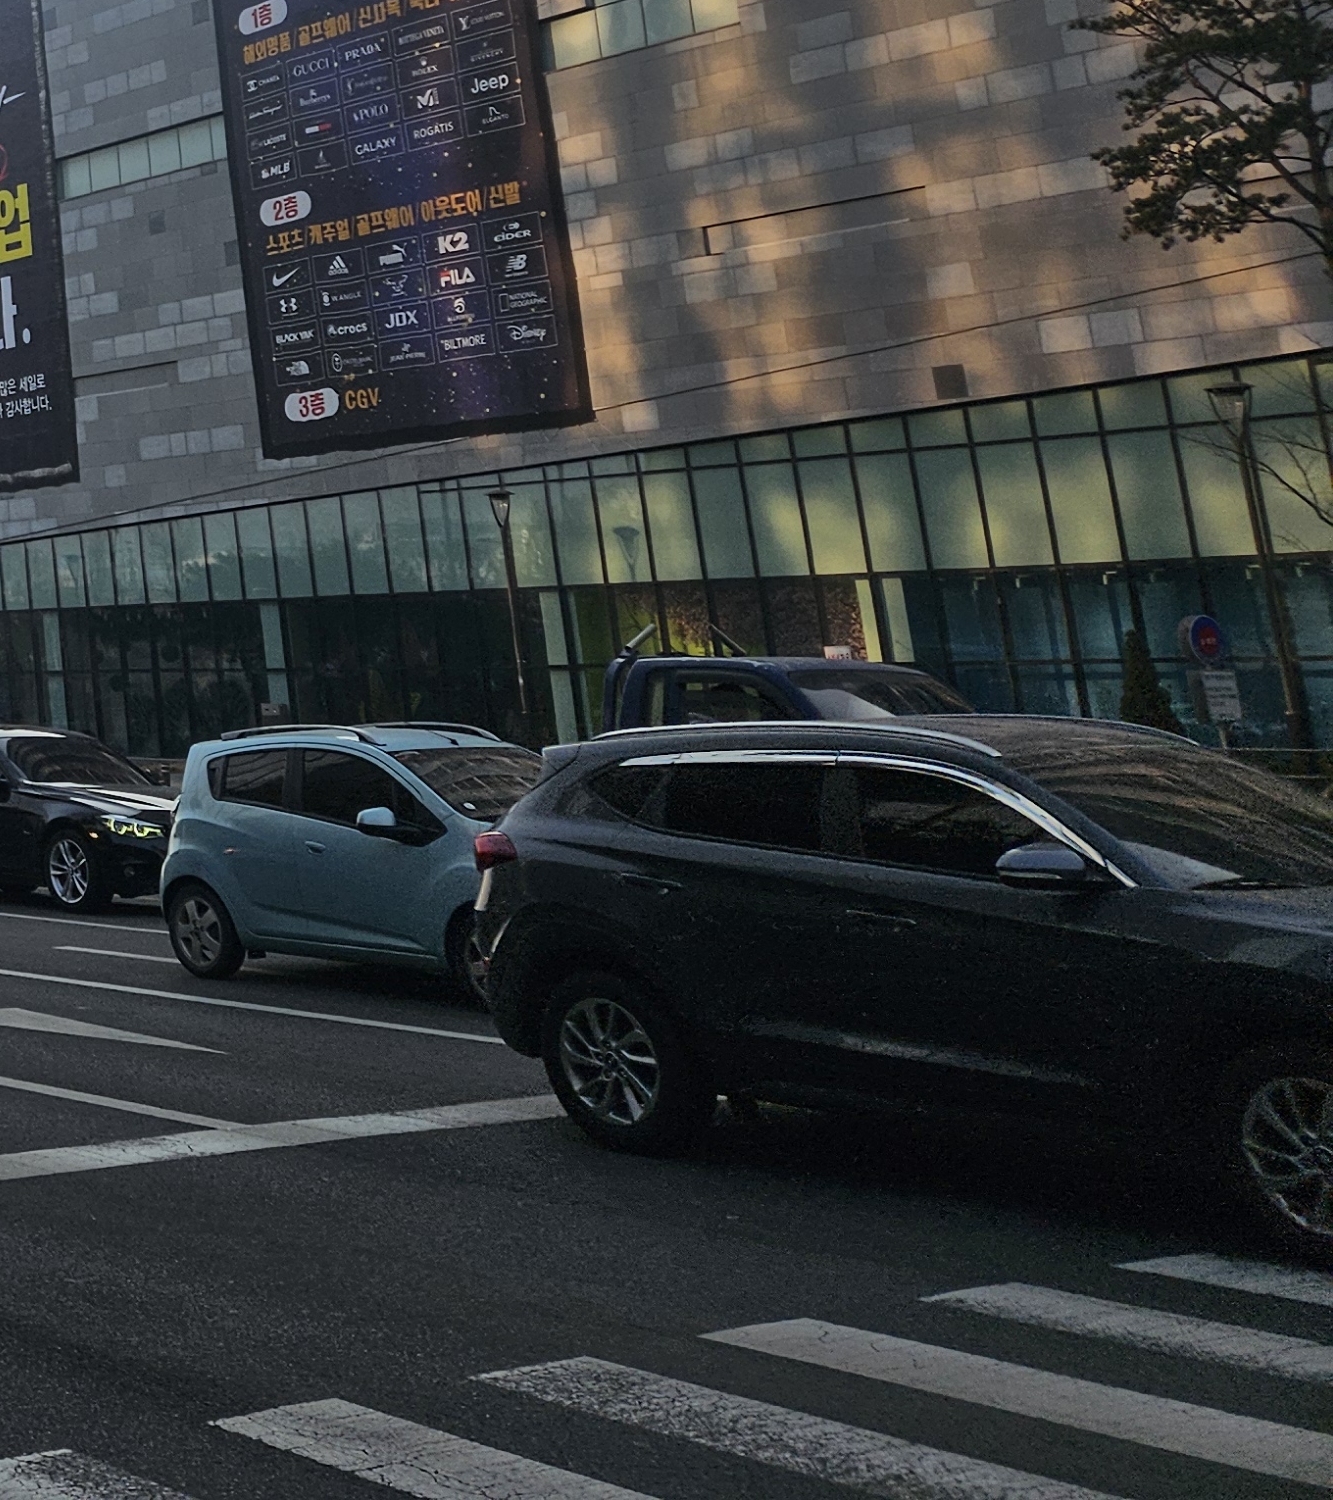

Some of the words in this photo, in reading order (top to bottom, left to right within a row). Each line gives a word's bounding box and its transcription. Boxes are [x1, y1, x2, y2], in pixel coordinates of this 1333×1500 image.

[251, 3, 272, 28] 1층
[345, 43, 382, 61] PRADA
[293, 58, 330, 77] GUCCI
[412, 65, 438, 77] ROLEX
[471, 74, 509, 94] Jeep
[359, 104, 389, 120] POLO
[413, 121, 454, 139] ROGATIS
[355, 136, 397, 156] GALAXY
[270, 161, 291, 176] MLB
[273, 195, 298, 221] 2층
[437, 231, 469, 254] K2
[440, 266, 476, 288] FILA
[337, 322, 368, 335] crocs
[384, 310, 419, 329] JDX
[0, 378, 16, 397] 많은
[19, 373, 46, 392] 세일로
[298, 391, 326, 418] 3층
[344, 387, 380, 411] CGV
